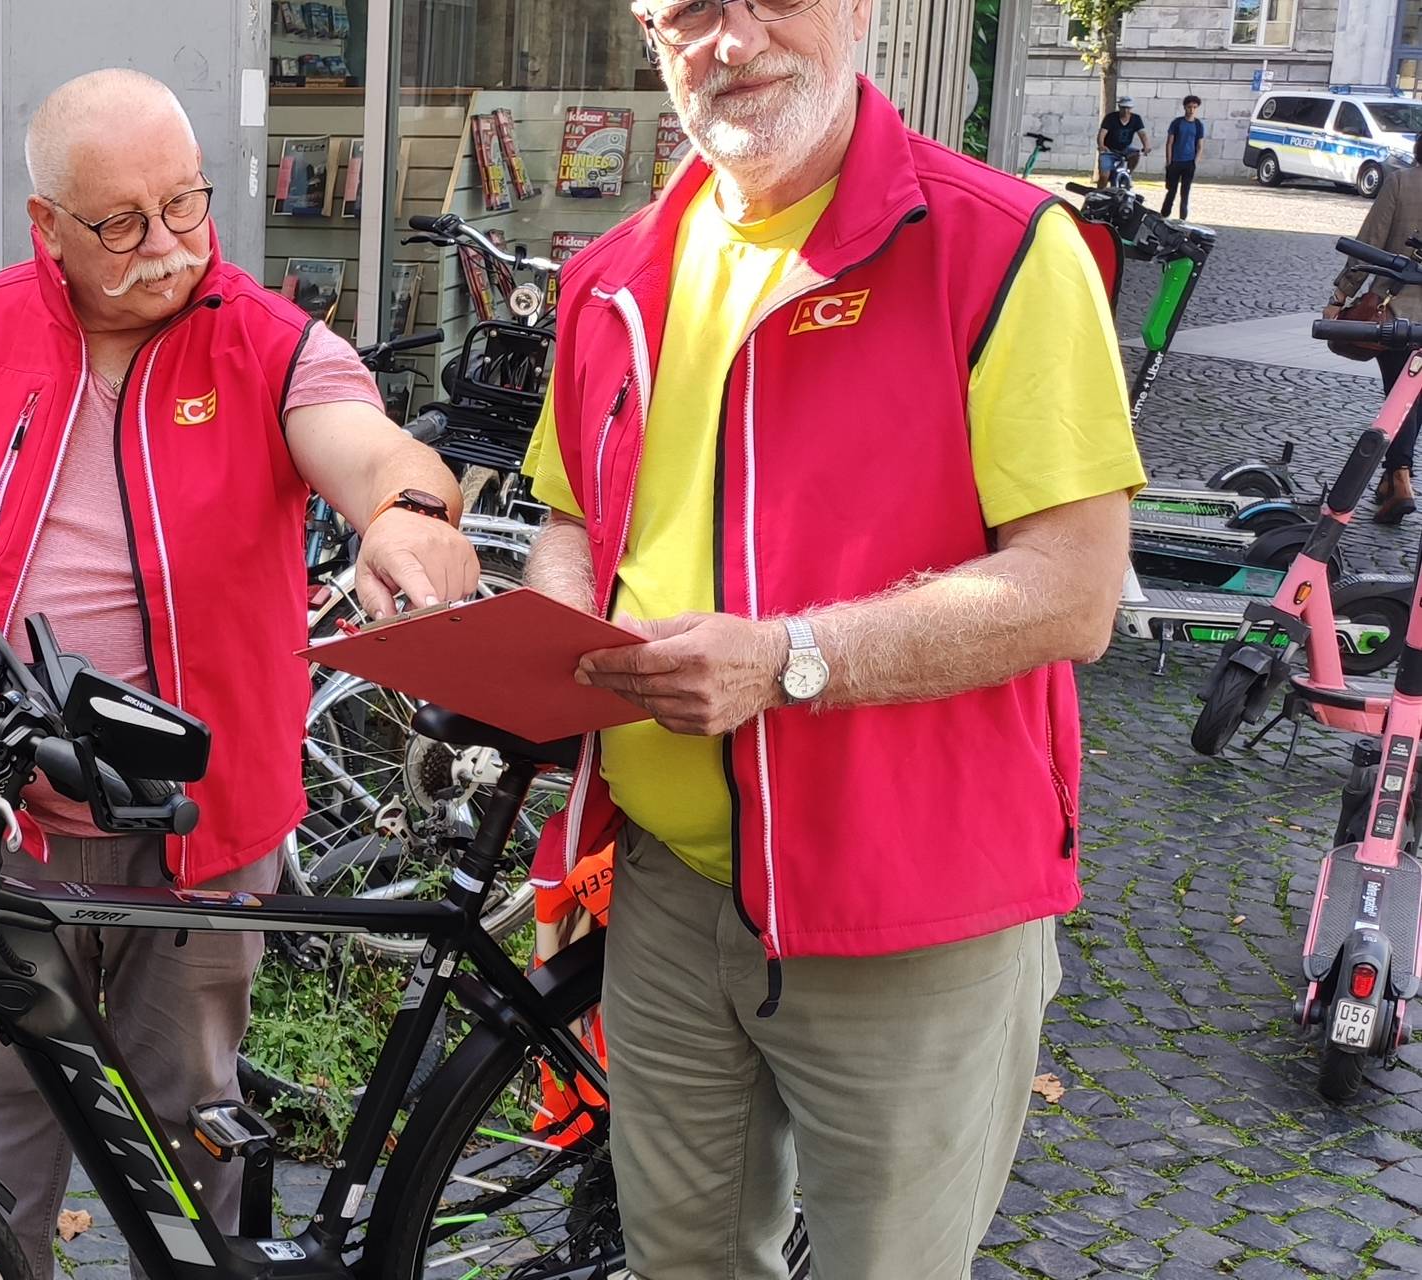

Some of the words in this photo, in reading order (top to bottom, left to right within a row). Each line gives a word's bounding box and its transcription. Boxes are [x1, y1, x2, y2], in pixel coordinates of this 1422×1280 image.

[569, 111, 603, 122] kicker
[295, 144, 326, 153] Crime
[1290, 136, 1317, 149] POLIZEI
[561, 154, 610, 169] BUNDES
[559, 166, 586, 180] LIGA
[555, 236, 590, 247] kicker
[300, 264, 334, 273] Crime
[789, 288, 870, 335] ACE
[1131, 391, 1148, 420] Lime
[1145, 351, 1164, 381] Uber
[174, 387, 216, 425] ACE
[121, 694, 154, 713] ARKHAM
[70, 909, 130, 923] SPORT
[1340, 1004, 1370, 1025] 056
[1335, 1023, 1366, 1045] WCA
